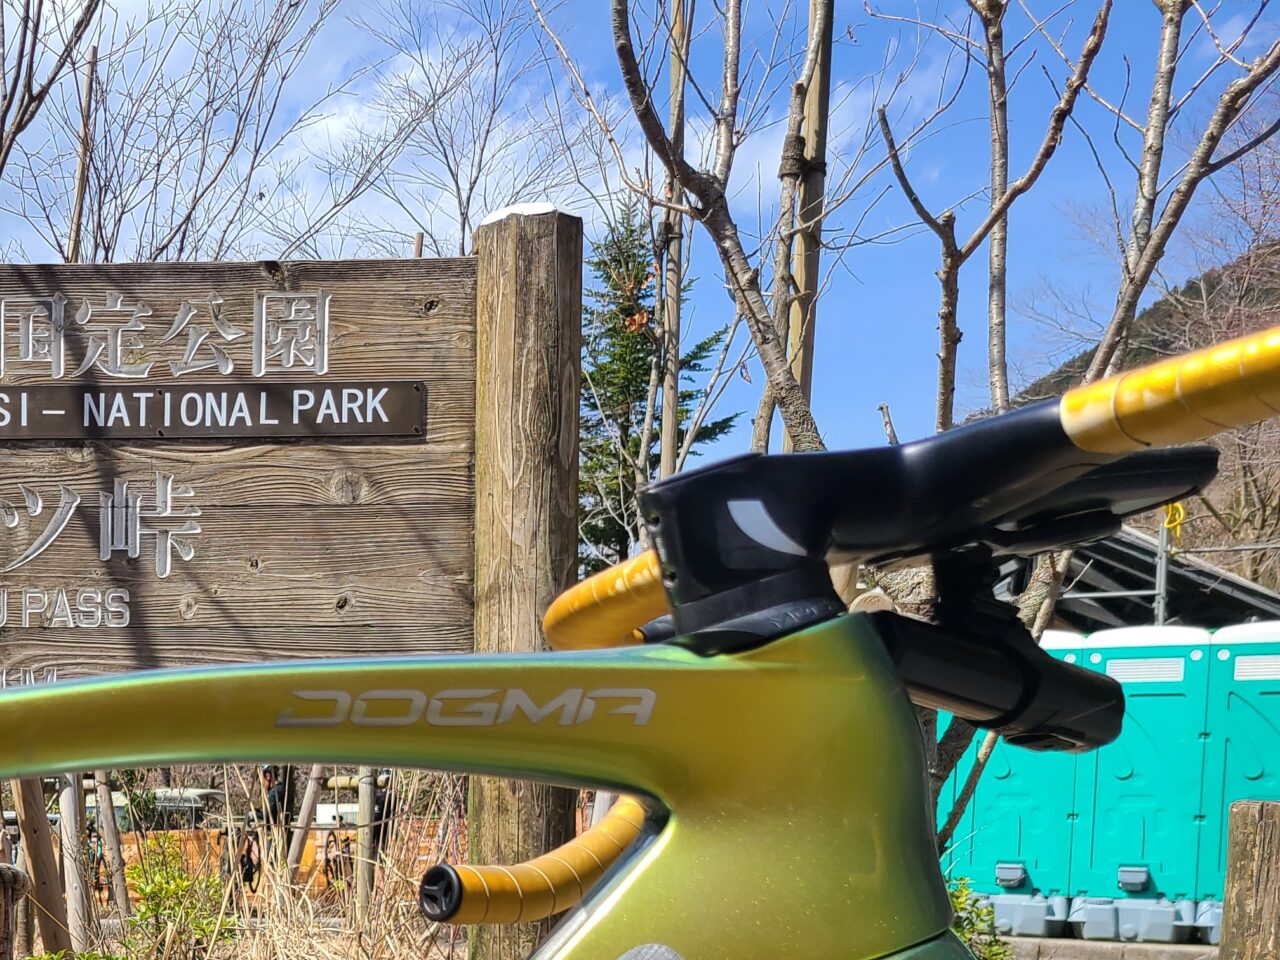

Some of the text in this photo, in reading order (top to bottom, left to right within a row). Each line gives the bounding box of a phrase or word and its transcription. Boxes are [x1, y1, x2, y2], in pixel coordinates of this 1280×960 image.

[292, 387, 390, 425] PARK
[21, 586, 131, 628] PASS
[273, 687, 657, 728] DOGMA
